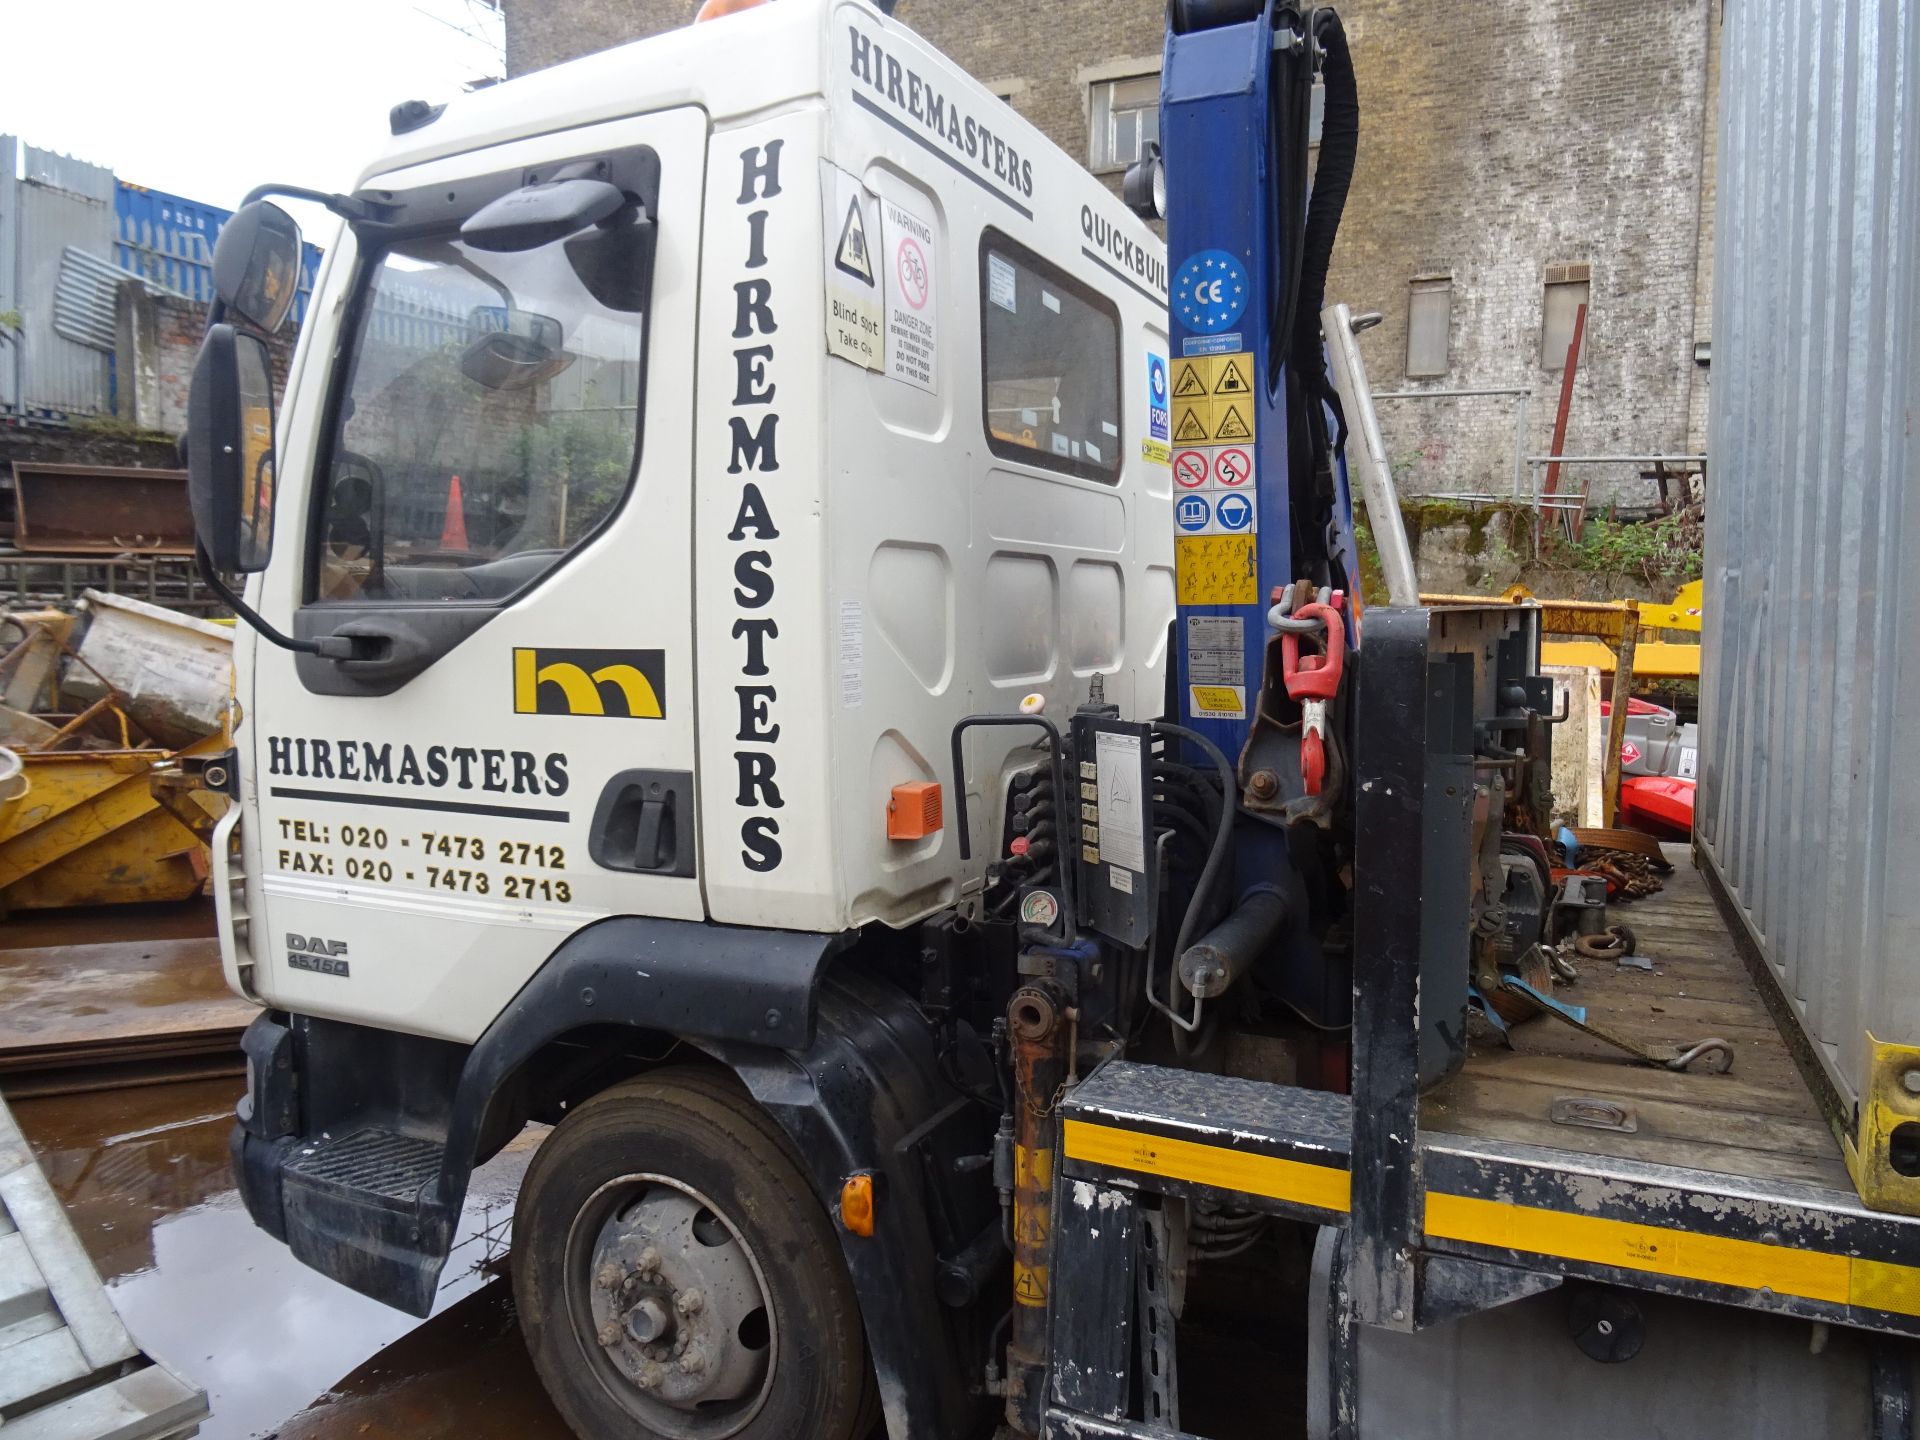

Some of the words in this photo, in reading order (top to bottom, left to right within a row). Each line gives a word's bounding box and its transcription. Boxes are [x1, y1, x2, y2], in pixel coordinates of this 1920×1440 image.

[849, 26, 1033, 198] HIREMASTERS
[888, 205, 931, 244] WARNING
[833, 300, 857, 324] Blind
[894, 309, 919, 330] DANGER
[919, 321, 932, 338] ZONE
[838, 328, 858, 350] Take
[727, 139, 786, 872] HIREMASTERS
[268, 736, 570, 797] HIREMASTERS
[279, 819, 329, 844] TEL:
[341, 825, 388, 850] 020
[421, 833, 485, 860] 7473
[499, 841, 566, 870] 2712
[278, 850, 334, 876] FAX:
[345, 857, 393, 883] 020
[426, 867, 490, 895] 7473
[504, 876, 572, 903] 2713
[286, 932, 348, 957] DAF
